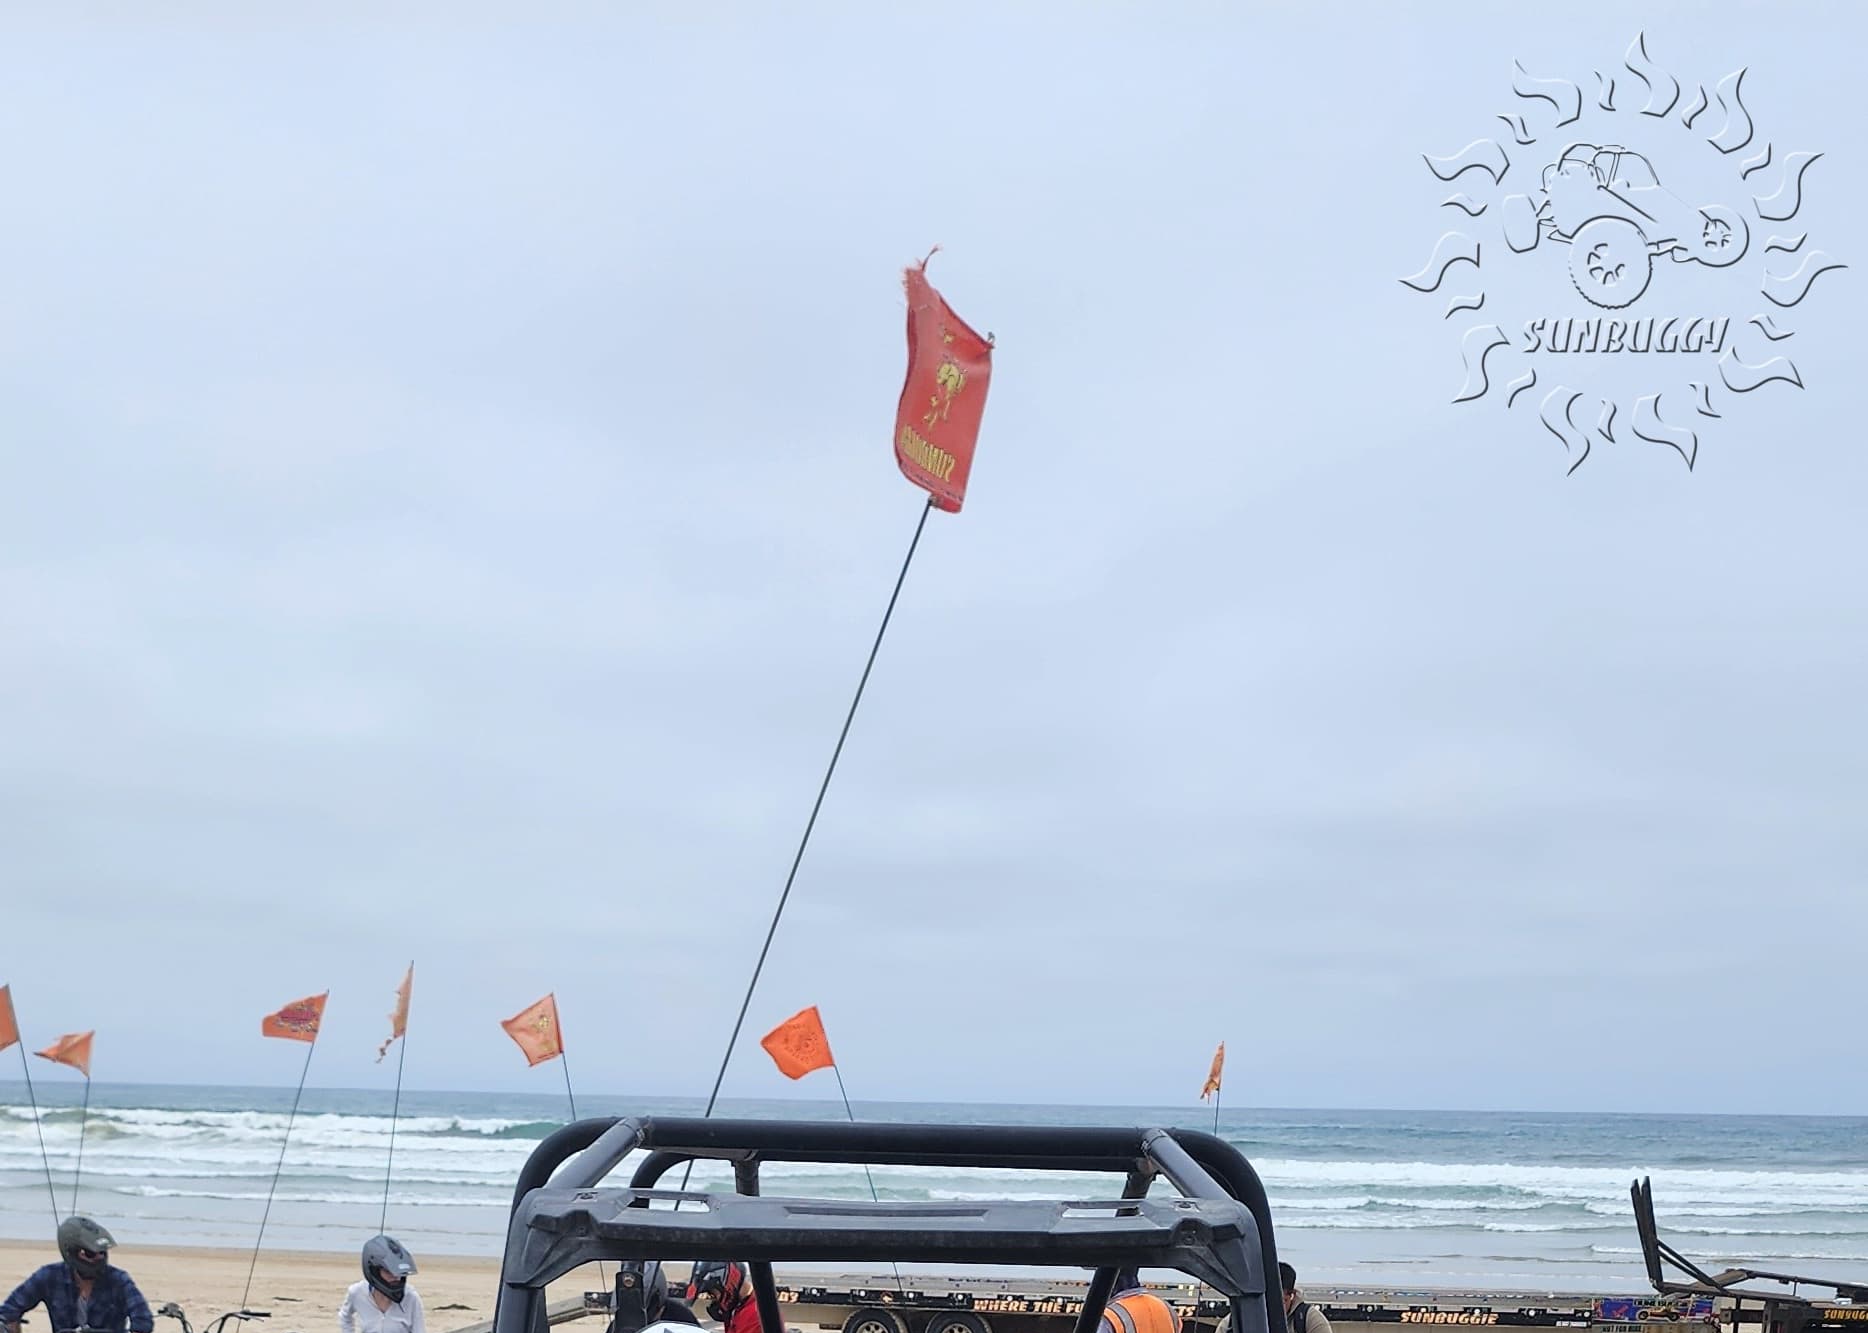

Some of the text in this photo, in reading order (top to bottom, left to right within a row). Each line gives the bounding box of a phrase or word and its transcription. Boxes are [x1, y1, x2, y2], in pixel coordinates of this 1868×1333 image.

[973, 1299, 1028, 1312] WHERE
[1032, 1301, 1064, 1313] THE
[1400, 1310, 1500, 1325] SUNBUGGIE
[1823, 1308, 1868, 1321] SUNBUG
